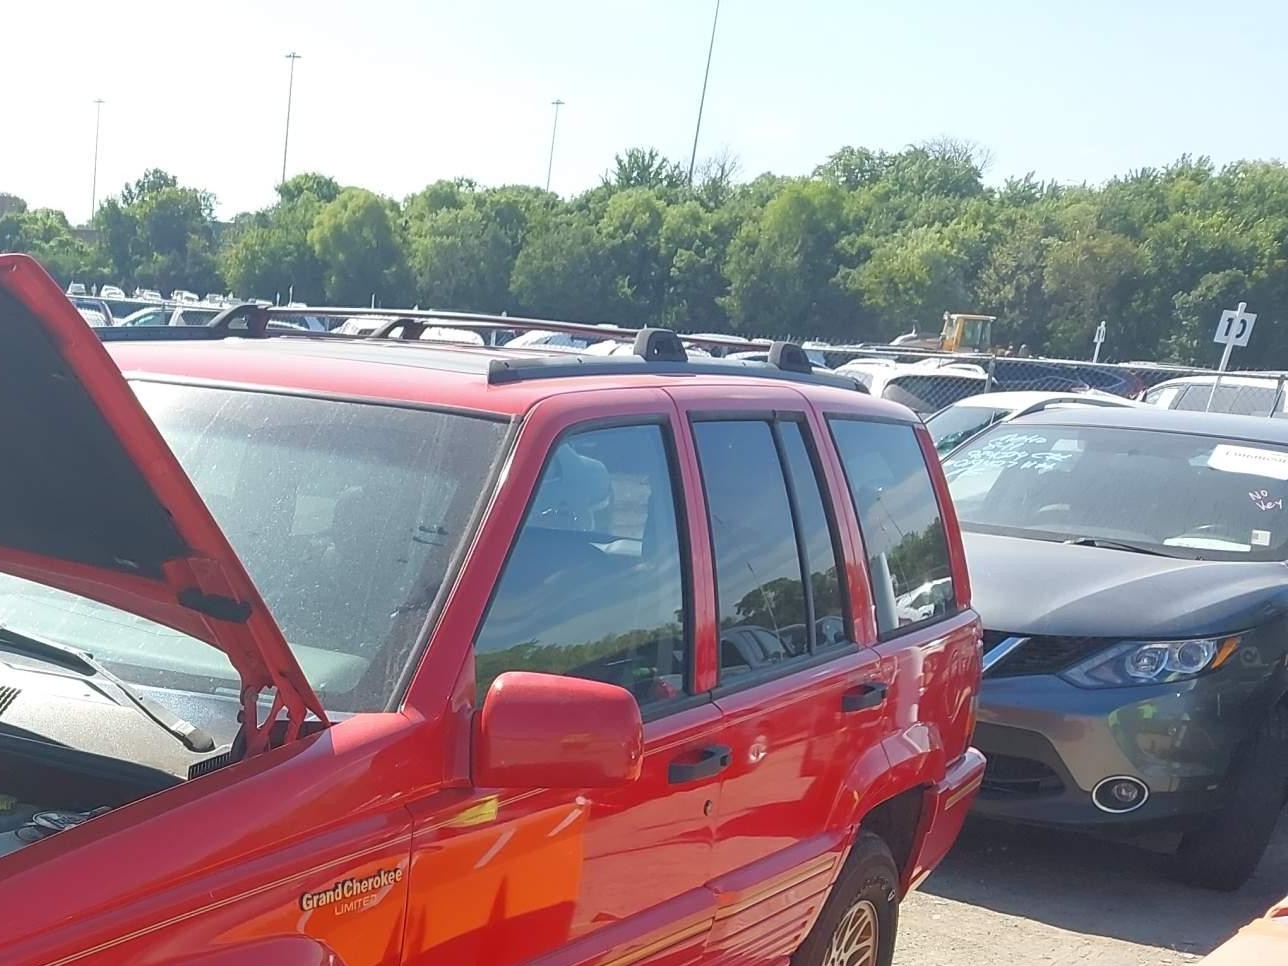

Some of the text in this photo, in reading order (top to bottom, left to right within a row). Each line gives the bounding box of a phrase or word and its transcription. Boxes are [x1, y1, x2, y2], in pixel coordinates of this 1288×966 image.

[300, 868, 404, 911] Grand Cherokee
[334, 893, 377, 916] LIMITED
